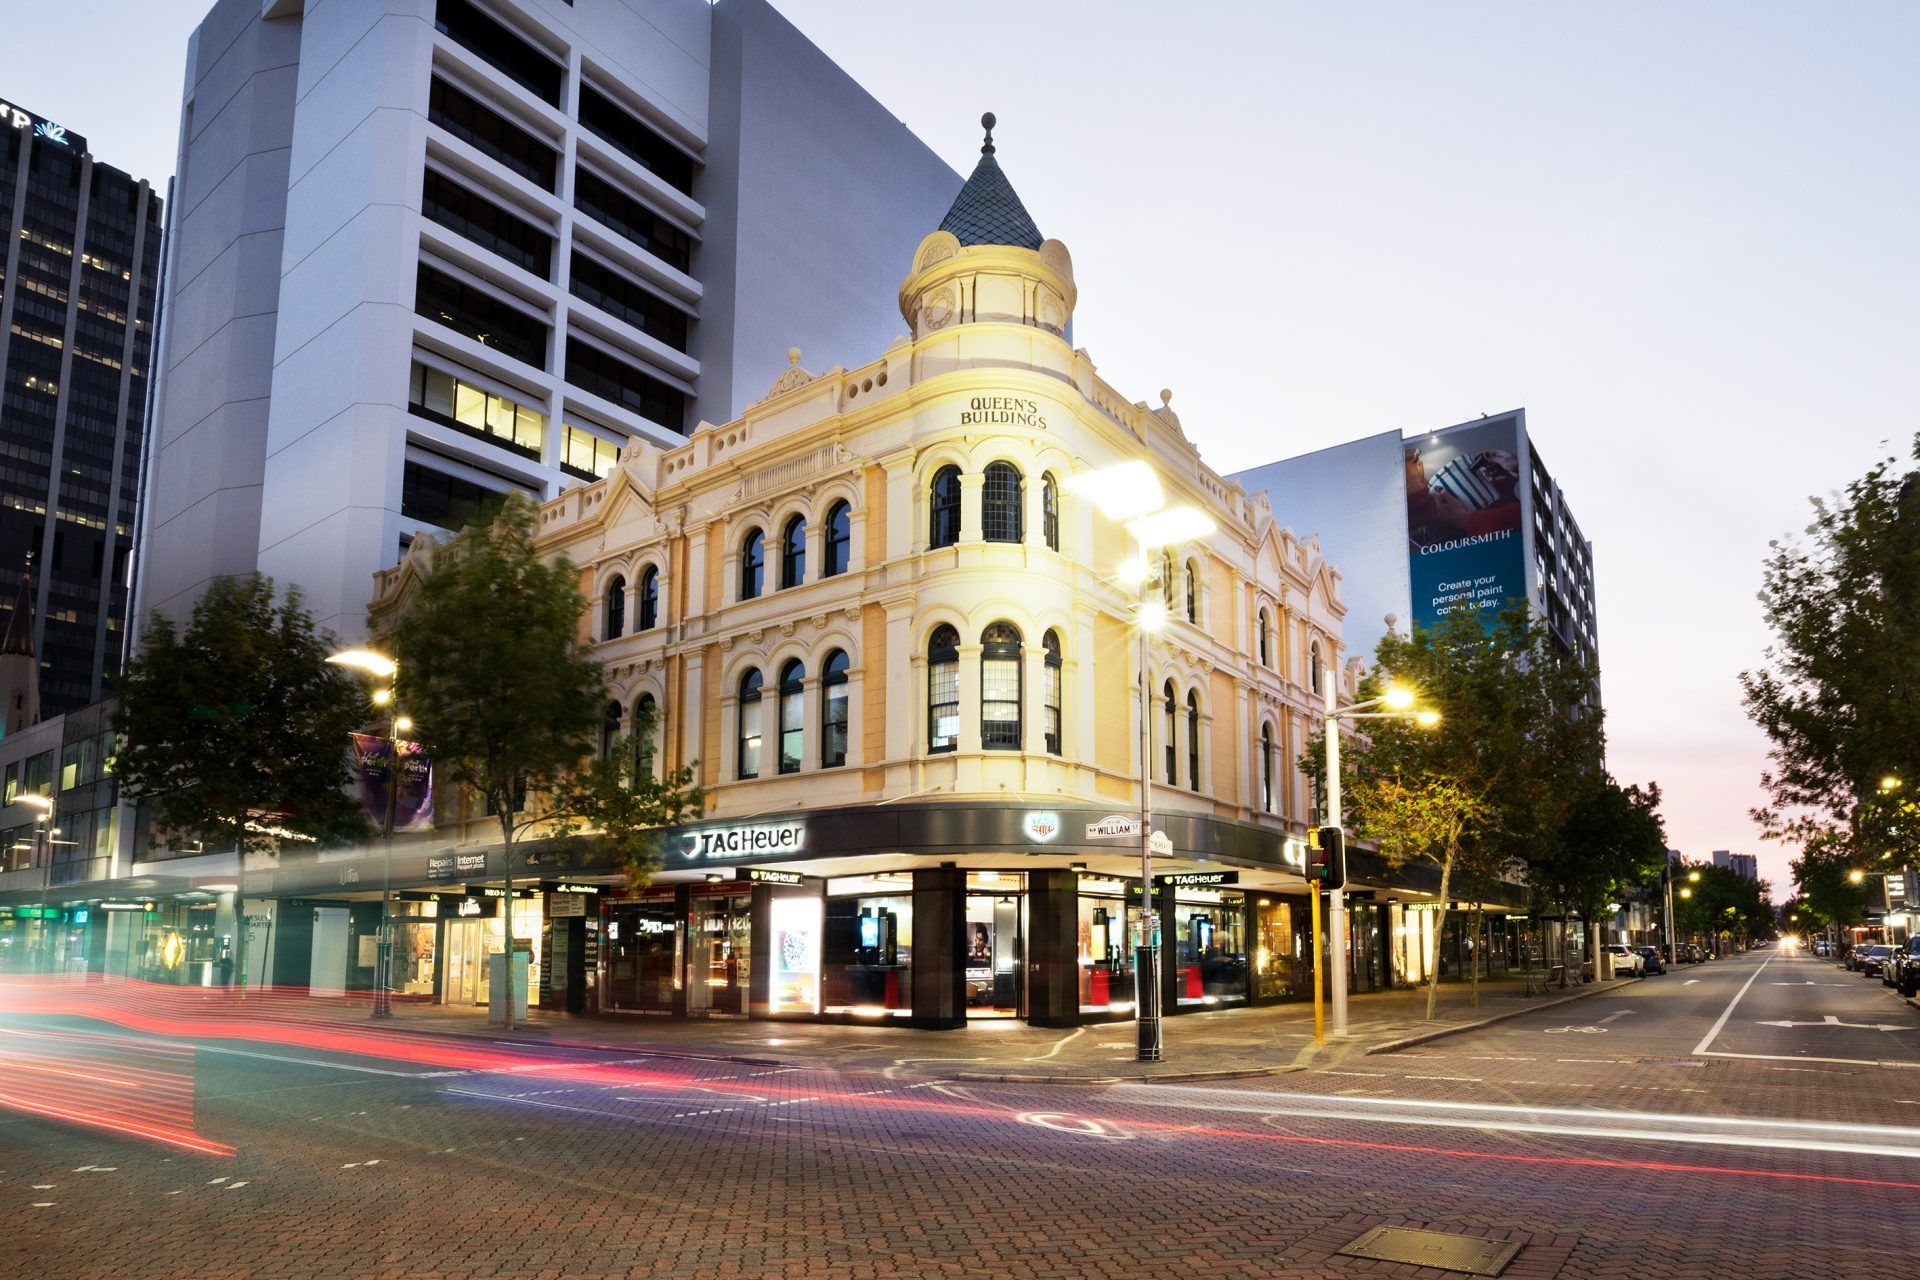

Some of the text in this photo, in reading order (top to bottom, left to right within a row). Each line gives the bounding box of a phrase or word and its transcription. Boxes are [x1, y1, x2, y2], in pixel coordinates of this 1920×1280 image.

[970, 397, 1037, 414] QUEEN'S
[961, 411, 1047, 429] BUILDINGS
[1420, 530, 1510, 555] COLOURSMITH
[1438, 575, 1496, 592] Create your
[1432, 585, 1503, 607] personal paint
[361, 756, 387, 768] Perth
[1097, 825, 1131, 836] WILLIAM
[430, 857, 453, 869] Repairs
[457, 854, 485, 865] Internet
